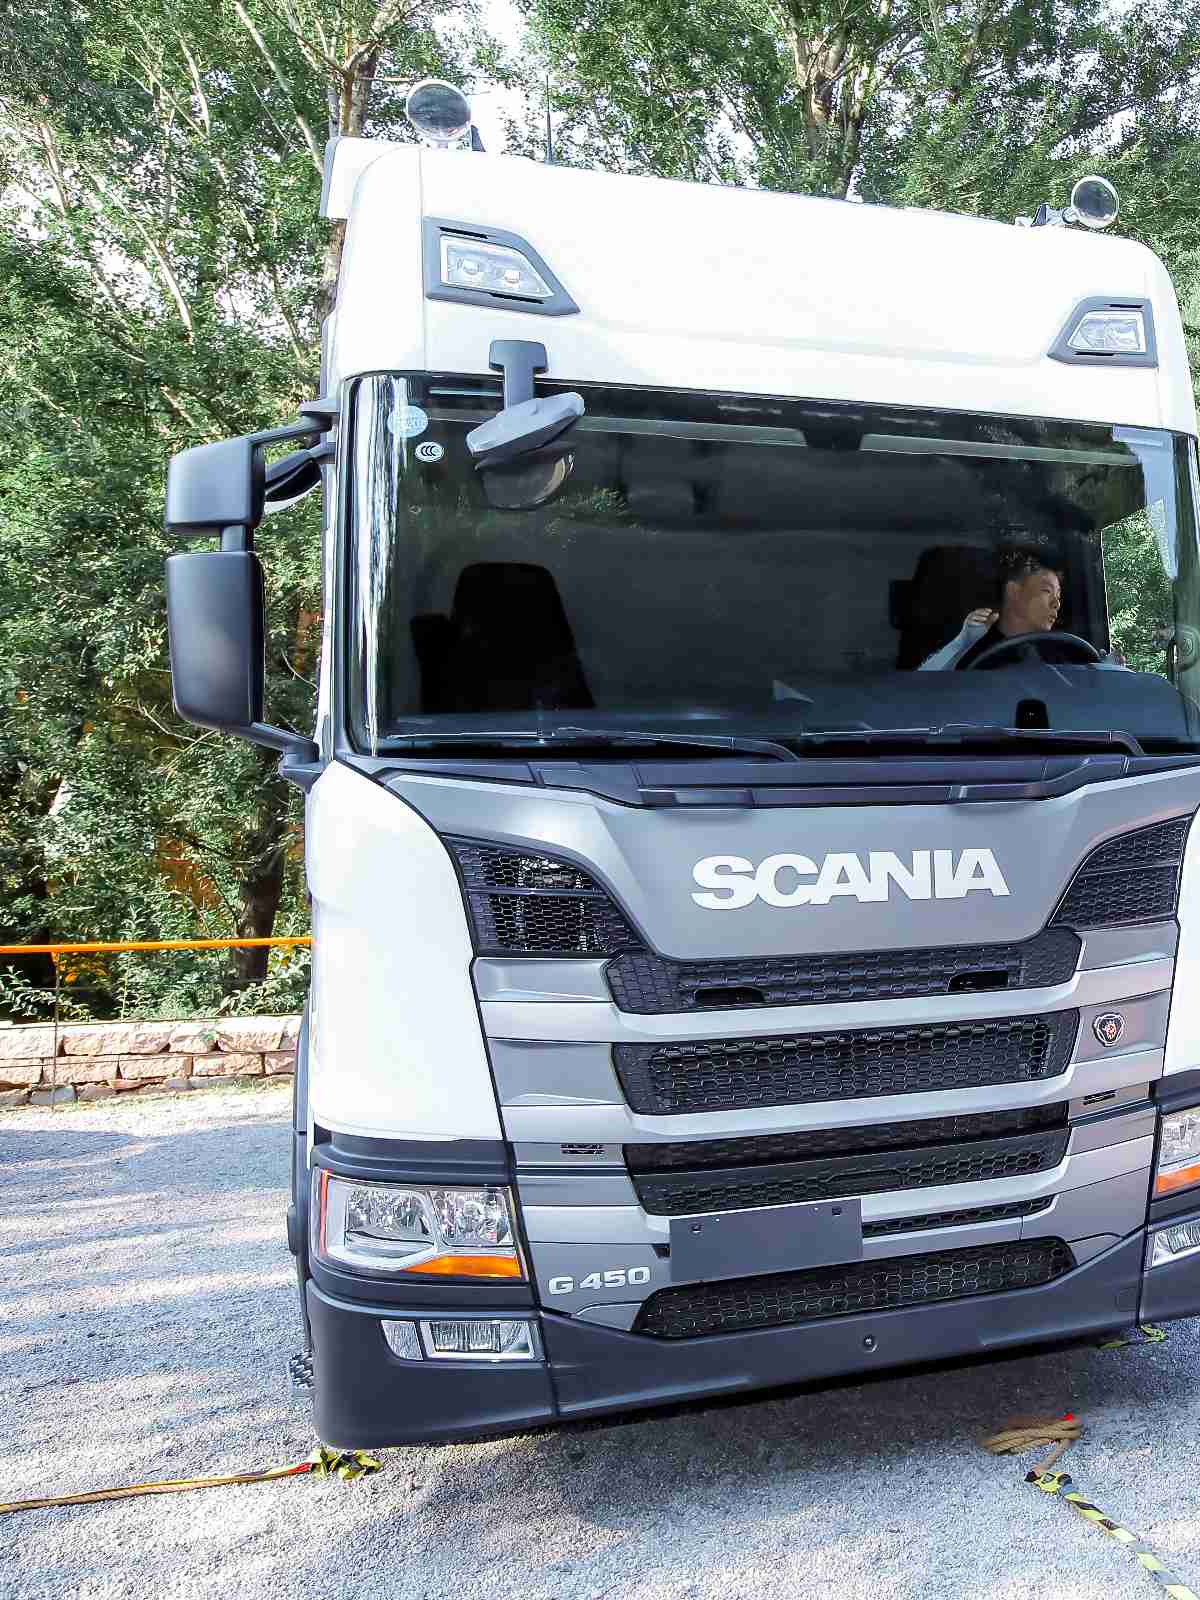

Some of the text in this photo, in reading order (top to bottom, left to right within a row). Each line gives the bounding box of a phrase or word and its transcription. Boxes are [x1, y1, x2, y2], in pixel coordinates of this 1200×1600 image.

[691, 848, 1010, 911] SCANIA
[548, 1266, 651, 1295] G 450
